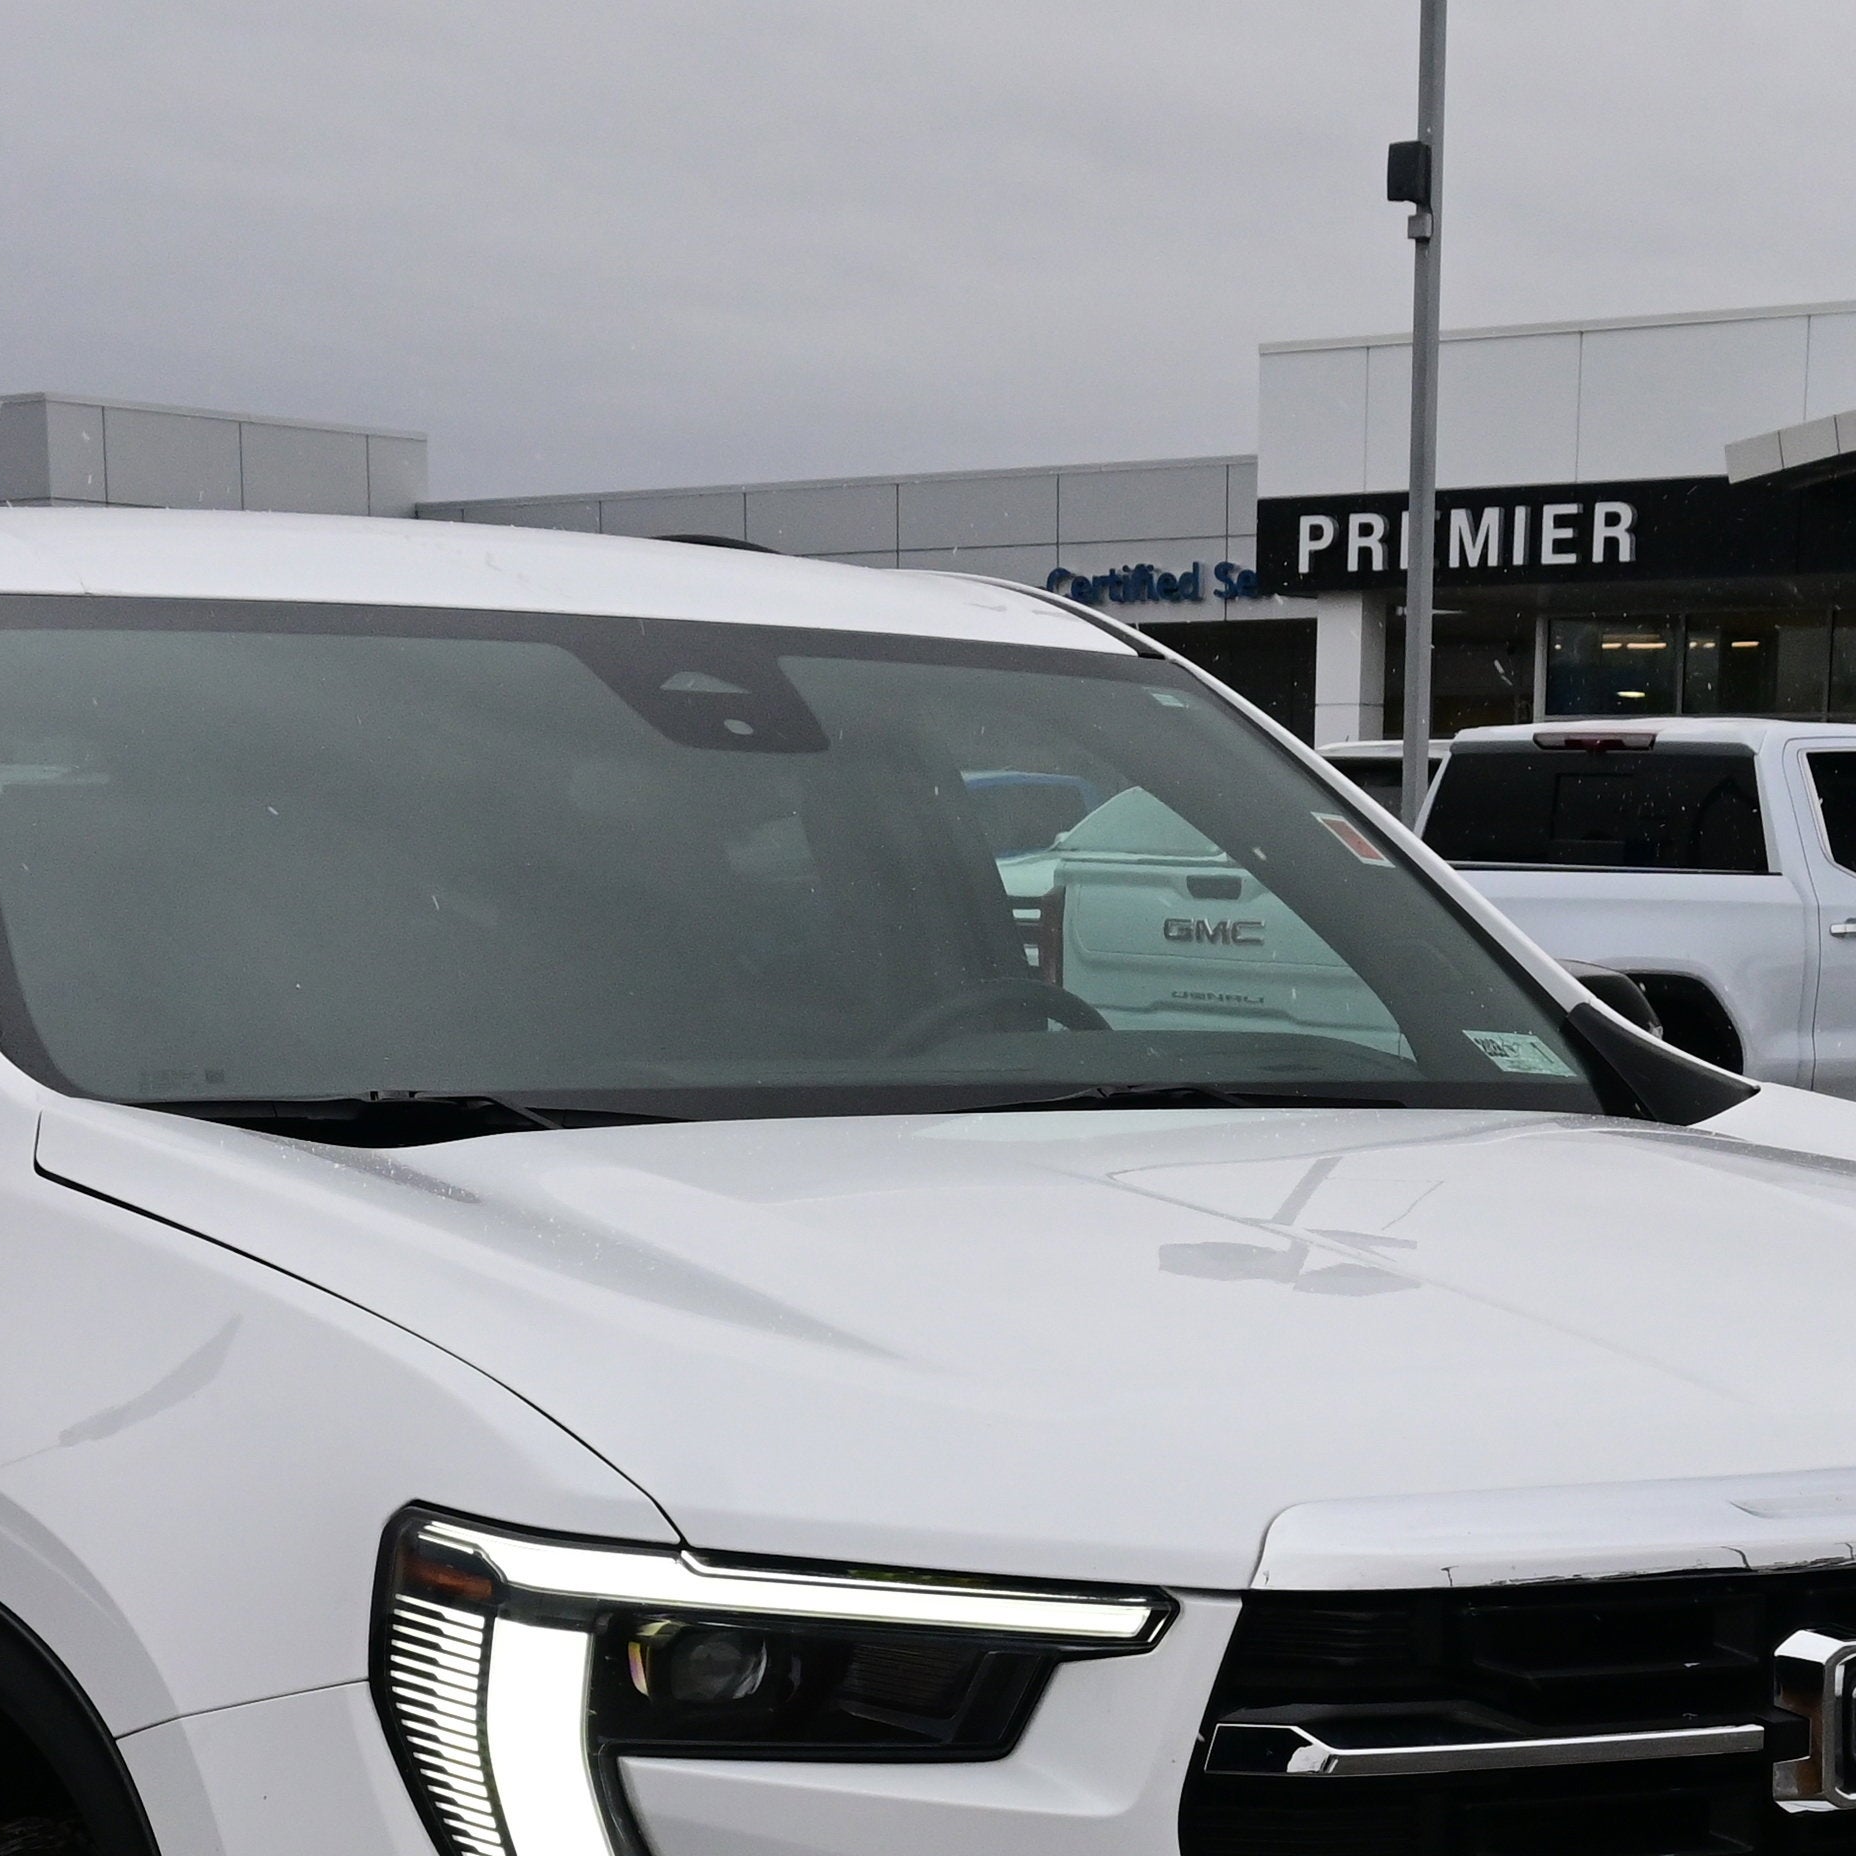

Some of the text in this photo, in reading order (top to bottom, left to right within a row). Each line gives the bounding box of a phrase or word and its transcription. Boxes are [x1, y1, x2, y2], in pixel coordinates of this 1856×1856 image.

[1046, 561, 1257, 602] Certified Se
[1164, 918, 1265, 945] GMC
